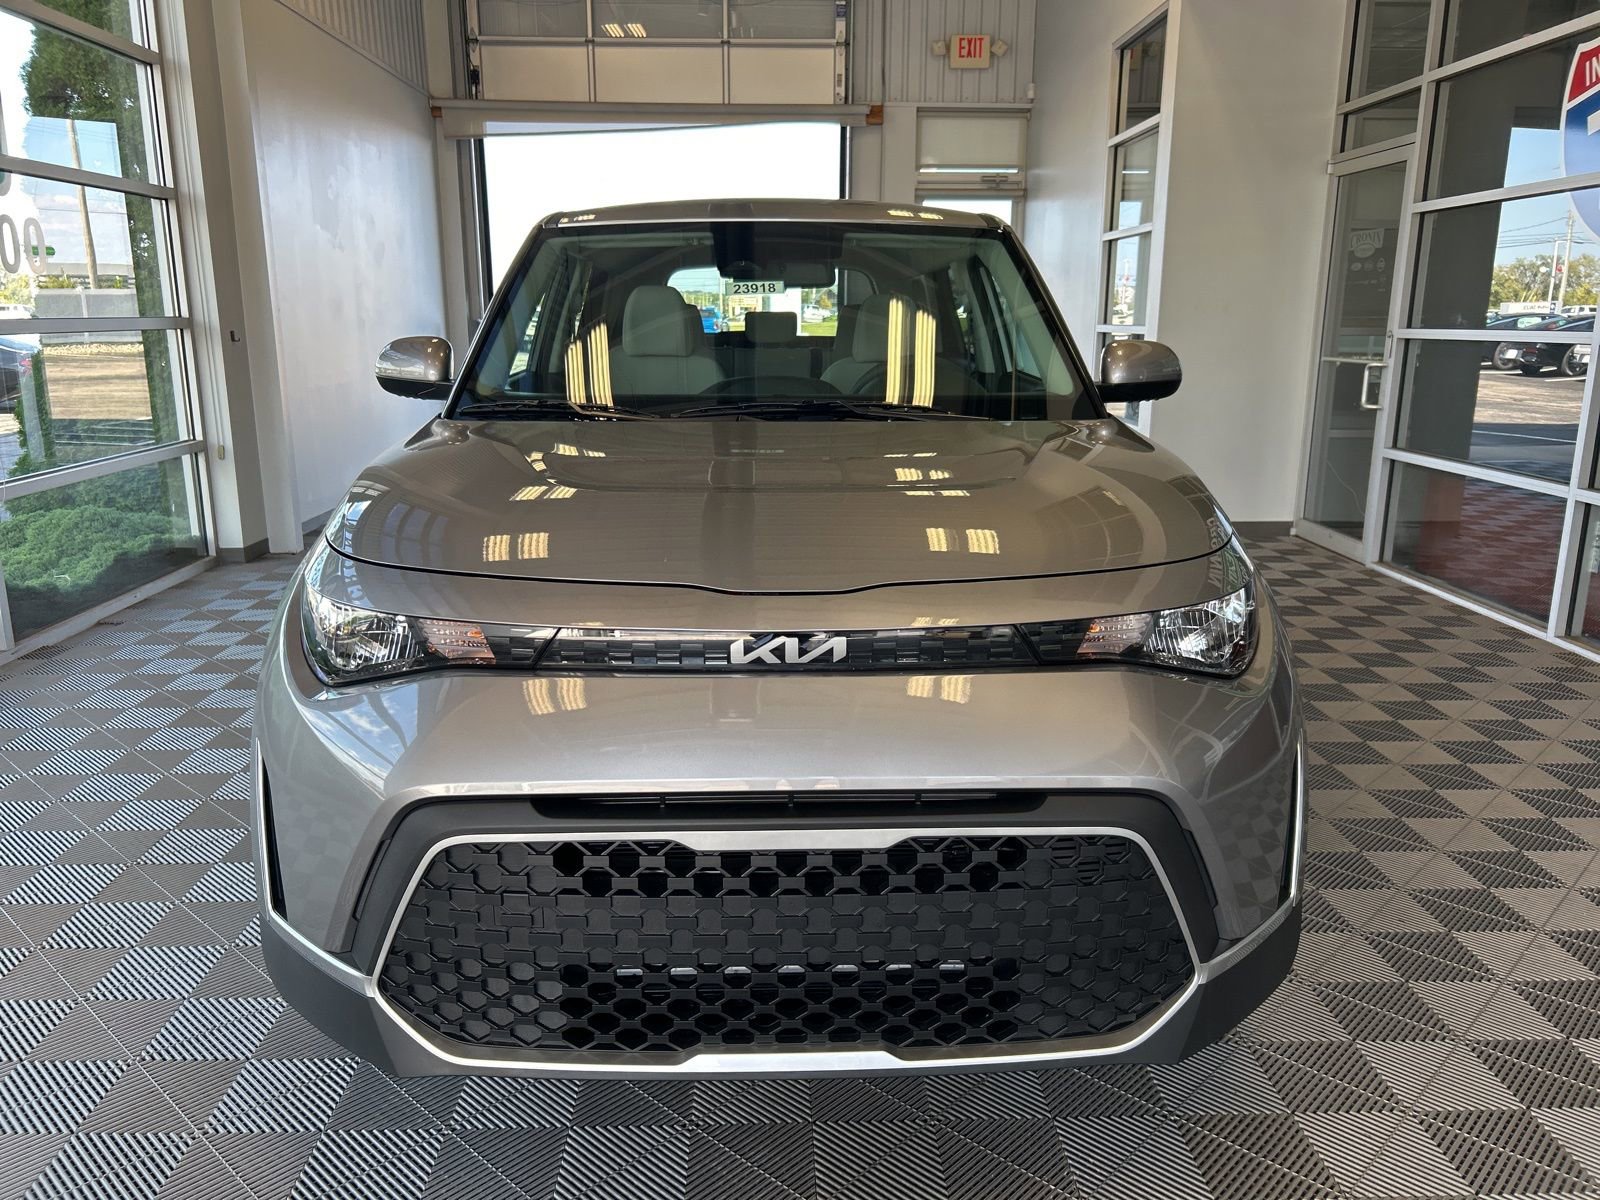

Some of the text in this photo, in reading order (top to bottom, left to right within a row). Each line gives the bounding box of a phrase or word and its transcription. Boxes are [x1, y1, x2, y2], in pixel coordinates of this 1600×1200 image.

[959, 37, 984, 58] EXIT
[733, 283, 776, 294] 23918
[730, 636, 847, 664] KIA
